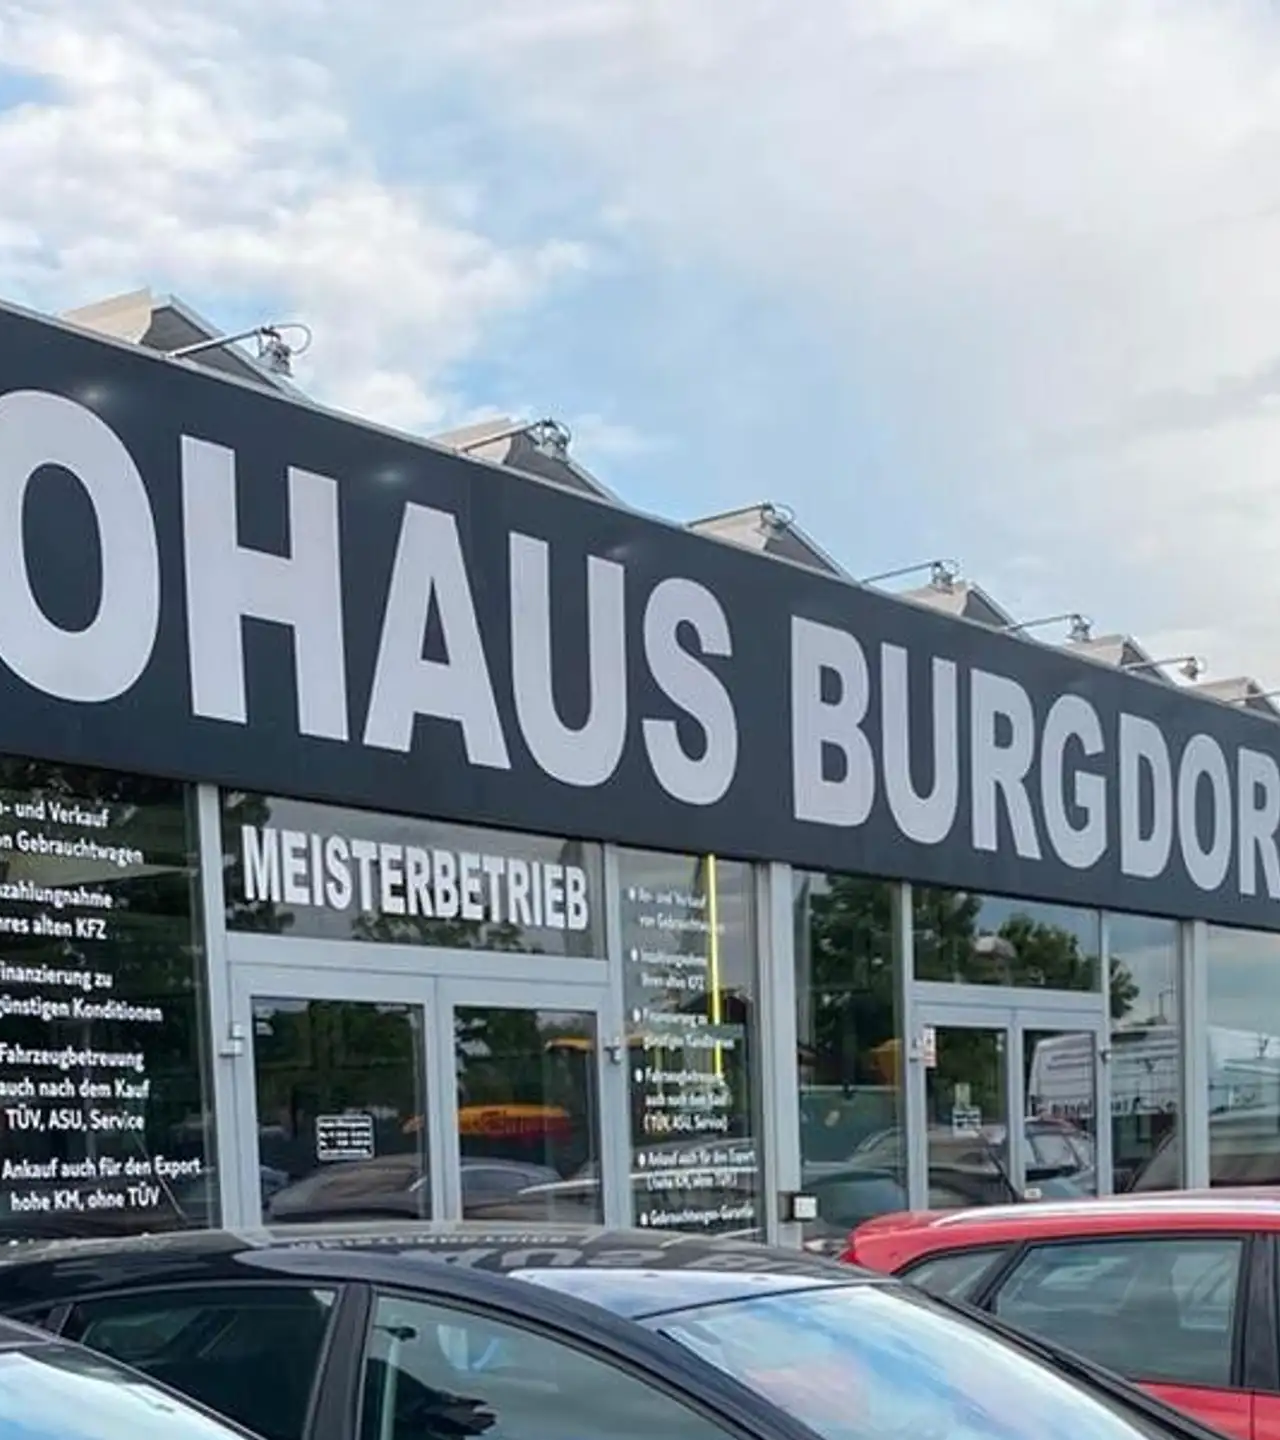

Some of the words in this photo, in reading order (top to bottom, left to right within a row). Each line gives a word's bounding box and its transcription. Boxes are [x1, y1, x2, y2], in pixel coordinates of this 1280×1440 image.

[15, 801, 45, 820] und
[48, 802, 109, 828] Verkauf
[17, 830, 144, 867] Gebrauchtwagen
[241, 825, 588, 930] MEISTERBETRIEB
[33, 913, 72, 937] alten
[76, 917, 107, 940] KFZ
[94, 972, 113, 988] zu
[72, 998, 163, 1022] Konditionen
[39, 1077, 75, 1097] nach
[79, 1078, 111, 1098] dem
[114, 1078, 151, 1098] Kauf
[49, 1109, 87, 1131] ASU,
[90, 1109, 145, 1130] Service
[2, 1157, 58, 1179] Ankauf
[61, 1158, 96, 1177] auch
[99, 1156, 122, 1176] für
[124, 1158, 151, 1175] den
[154, 1155, 201, 1179] Export
[10, 1190, 50, 1211] hohe
[54, 1191, 85, 1212] KM,
[88, 1188, 125, 1208] ohne
[128, 1181, 160, 1206] TÜV
